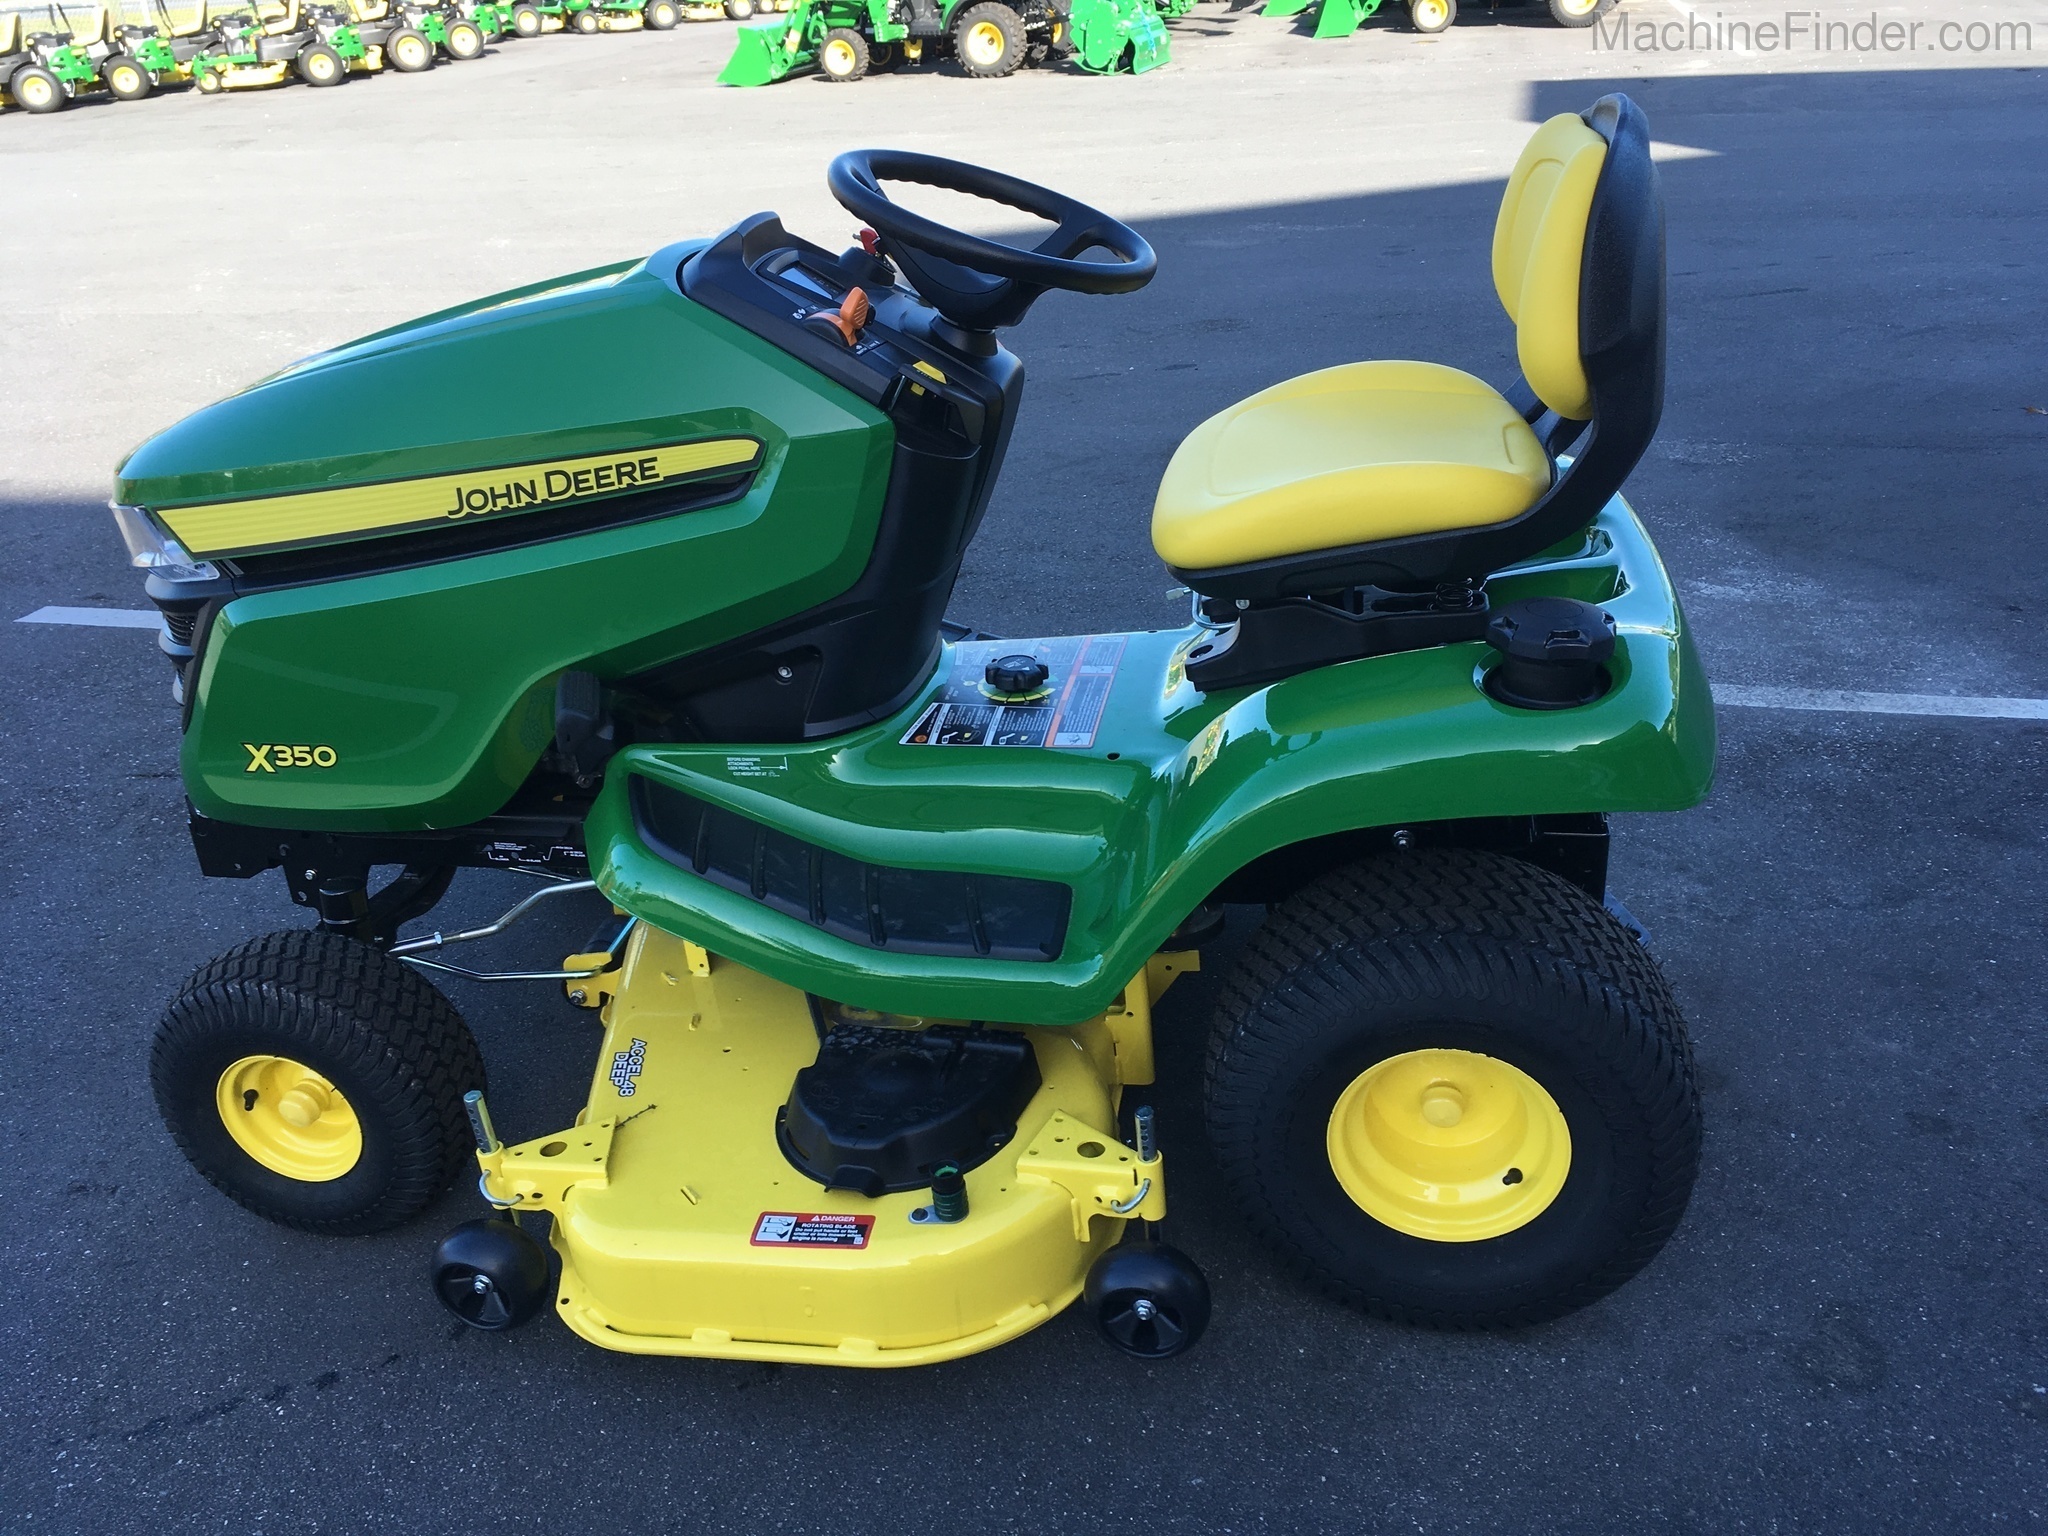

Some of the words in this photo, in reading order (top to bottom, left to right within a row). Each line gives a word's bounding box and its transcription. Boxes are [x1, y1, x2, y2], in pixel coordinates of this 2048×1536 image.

[447, 479, 538, 516] JOHN
[544, 456, 660, 498] DEERE
[243, 743, 337, 773] X350
[610, 1052, 630, 1087] DEEP
